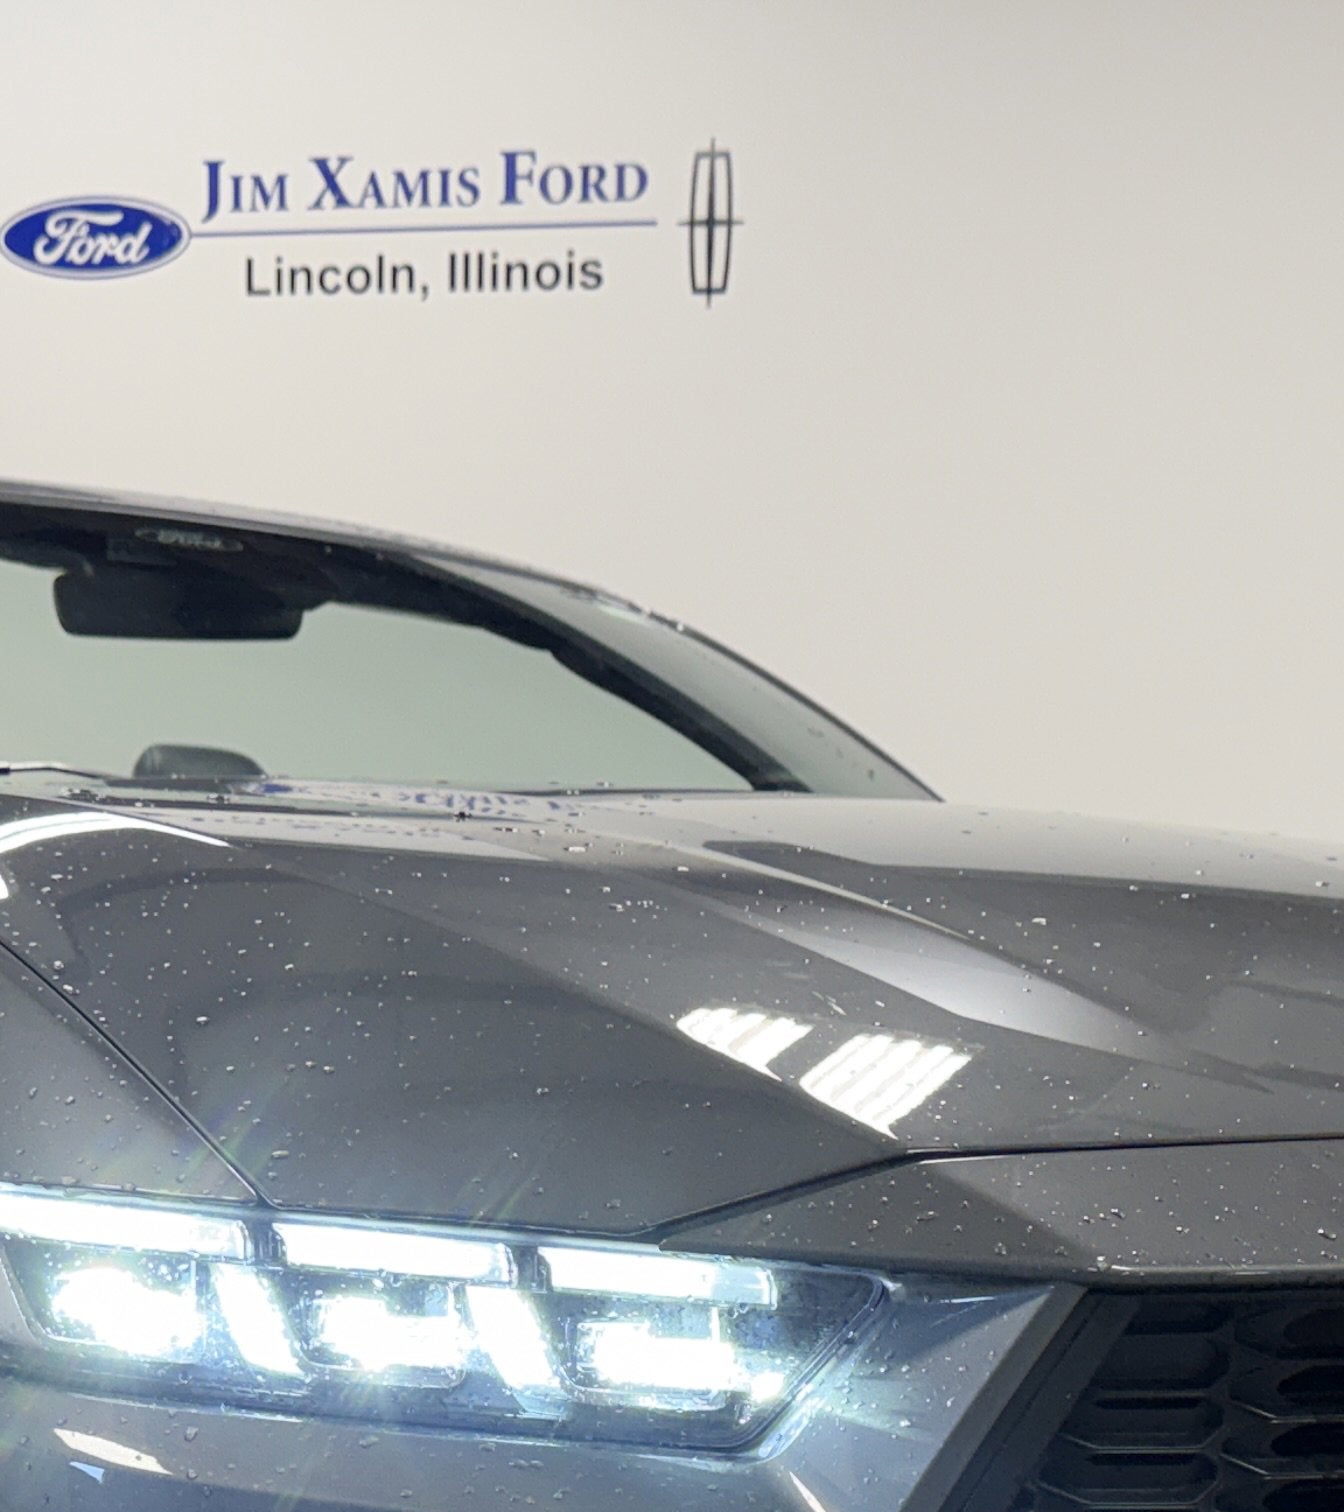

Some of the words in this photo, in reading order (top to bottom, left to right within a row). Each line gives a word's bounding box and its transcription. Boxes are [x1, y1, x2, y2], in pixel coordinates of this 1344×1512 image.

[201, 159, 289, 223] JIM
[307, 155, 481, 211] XAMIS
[499, 149, 649, 206] FORD
[33, 210, 153, 266] Ford
[246, 253, 430, 302] Lincoln,
[448, 248, 604, 293] Illinois
